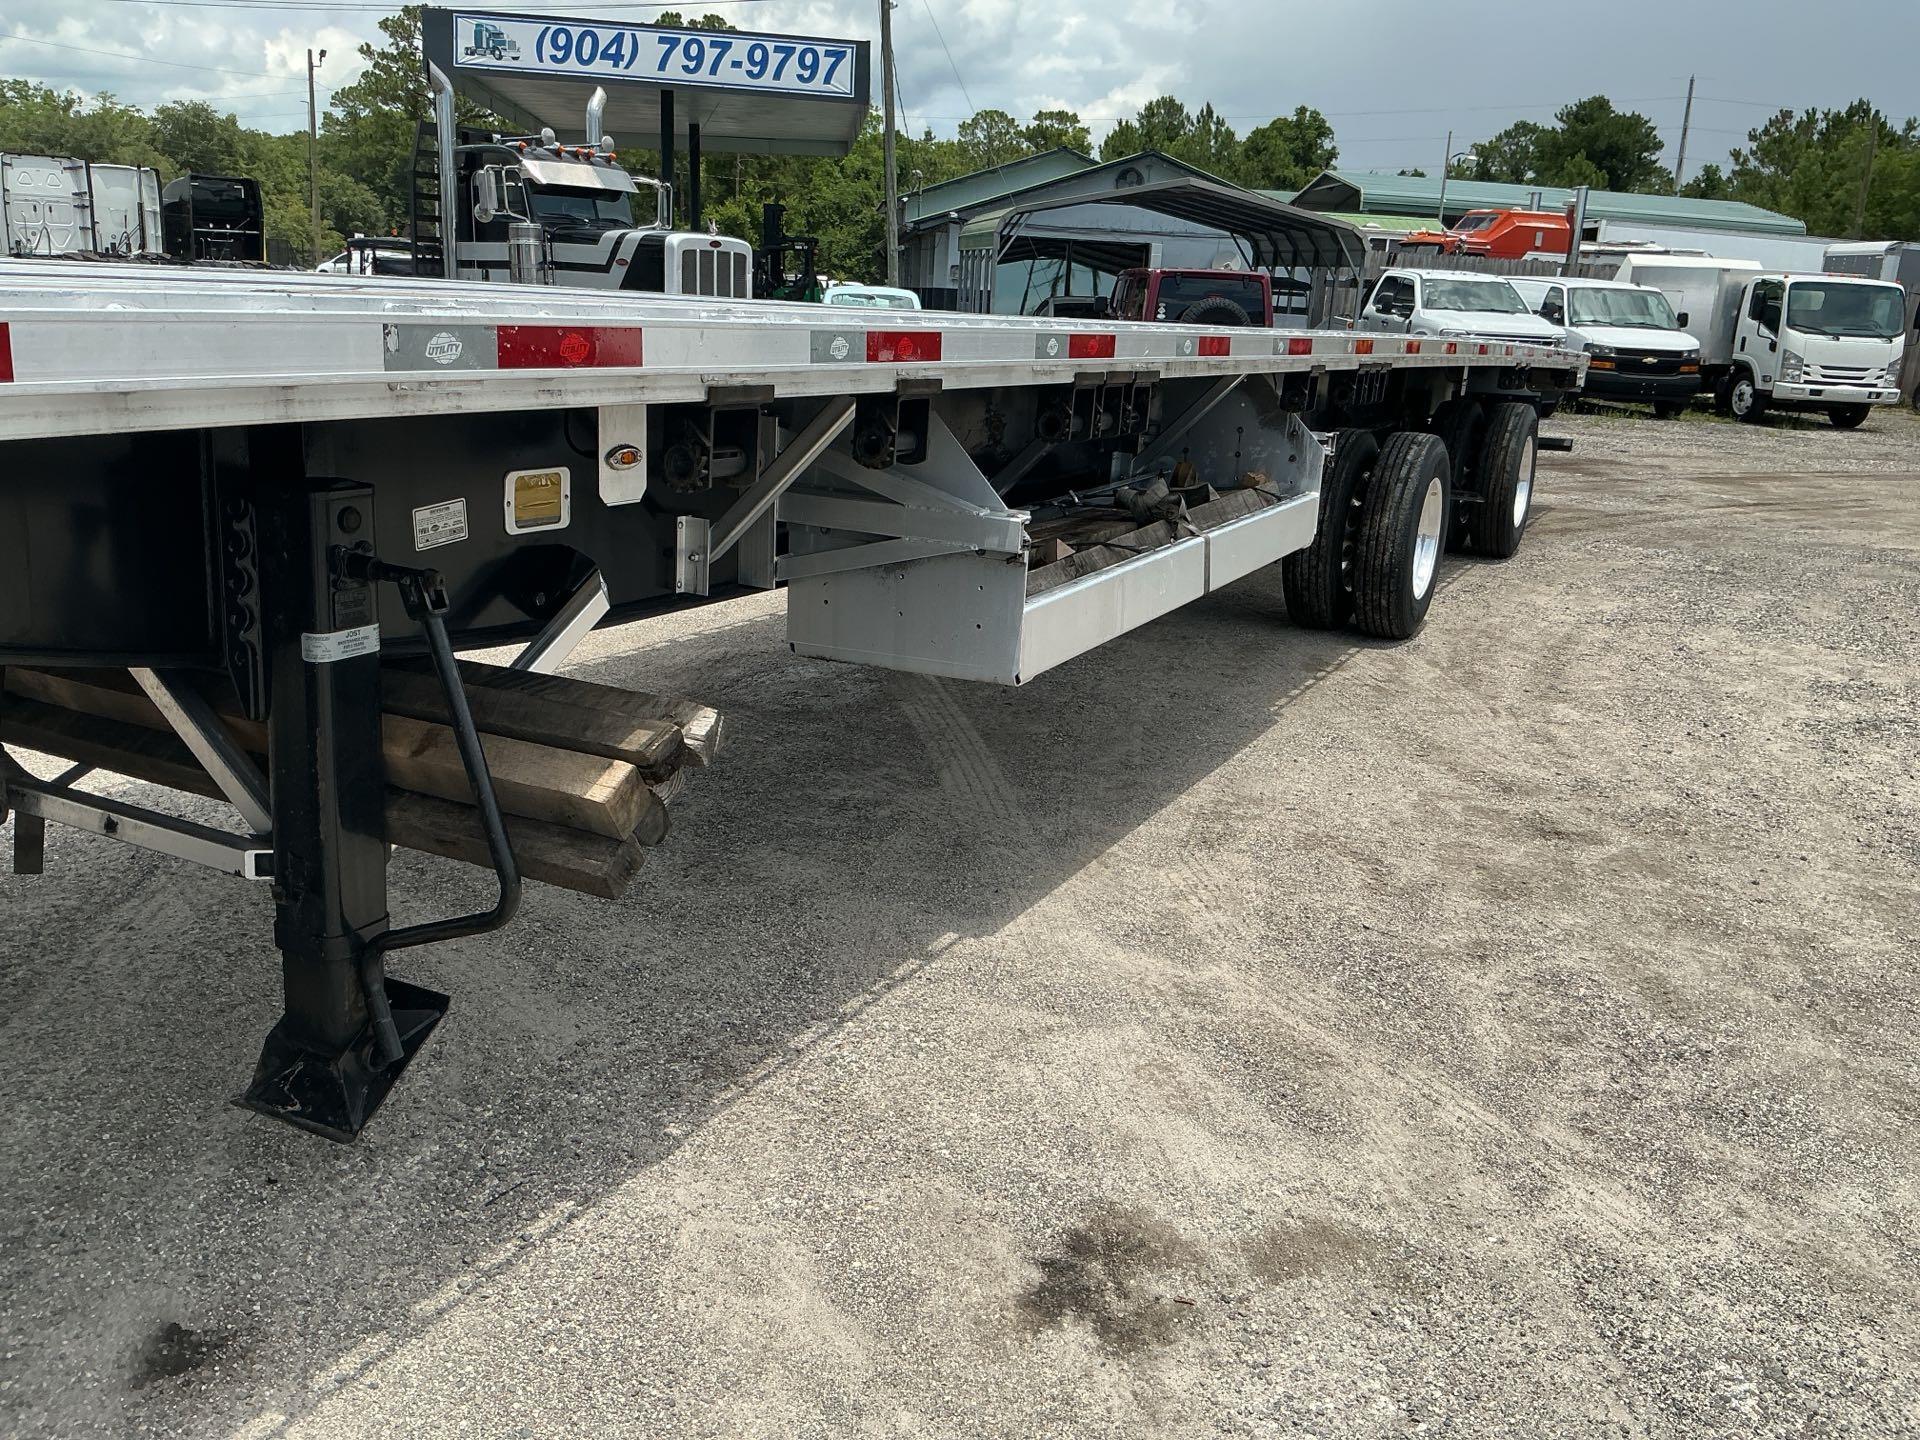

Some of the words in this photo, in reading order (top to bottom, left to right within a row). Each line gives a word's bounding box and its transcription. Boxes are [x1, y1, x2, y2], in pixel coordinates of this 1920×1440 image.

[535, 26, 639, 70] (904)
[656, 35, 847, 85] 797-9797
[428, 342, 461, 355] UTILITY
[562, 344, 588, 355] UTILITY
[346, 630, 361, 638] JOST
